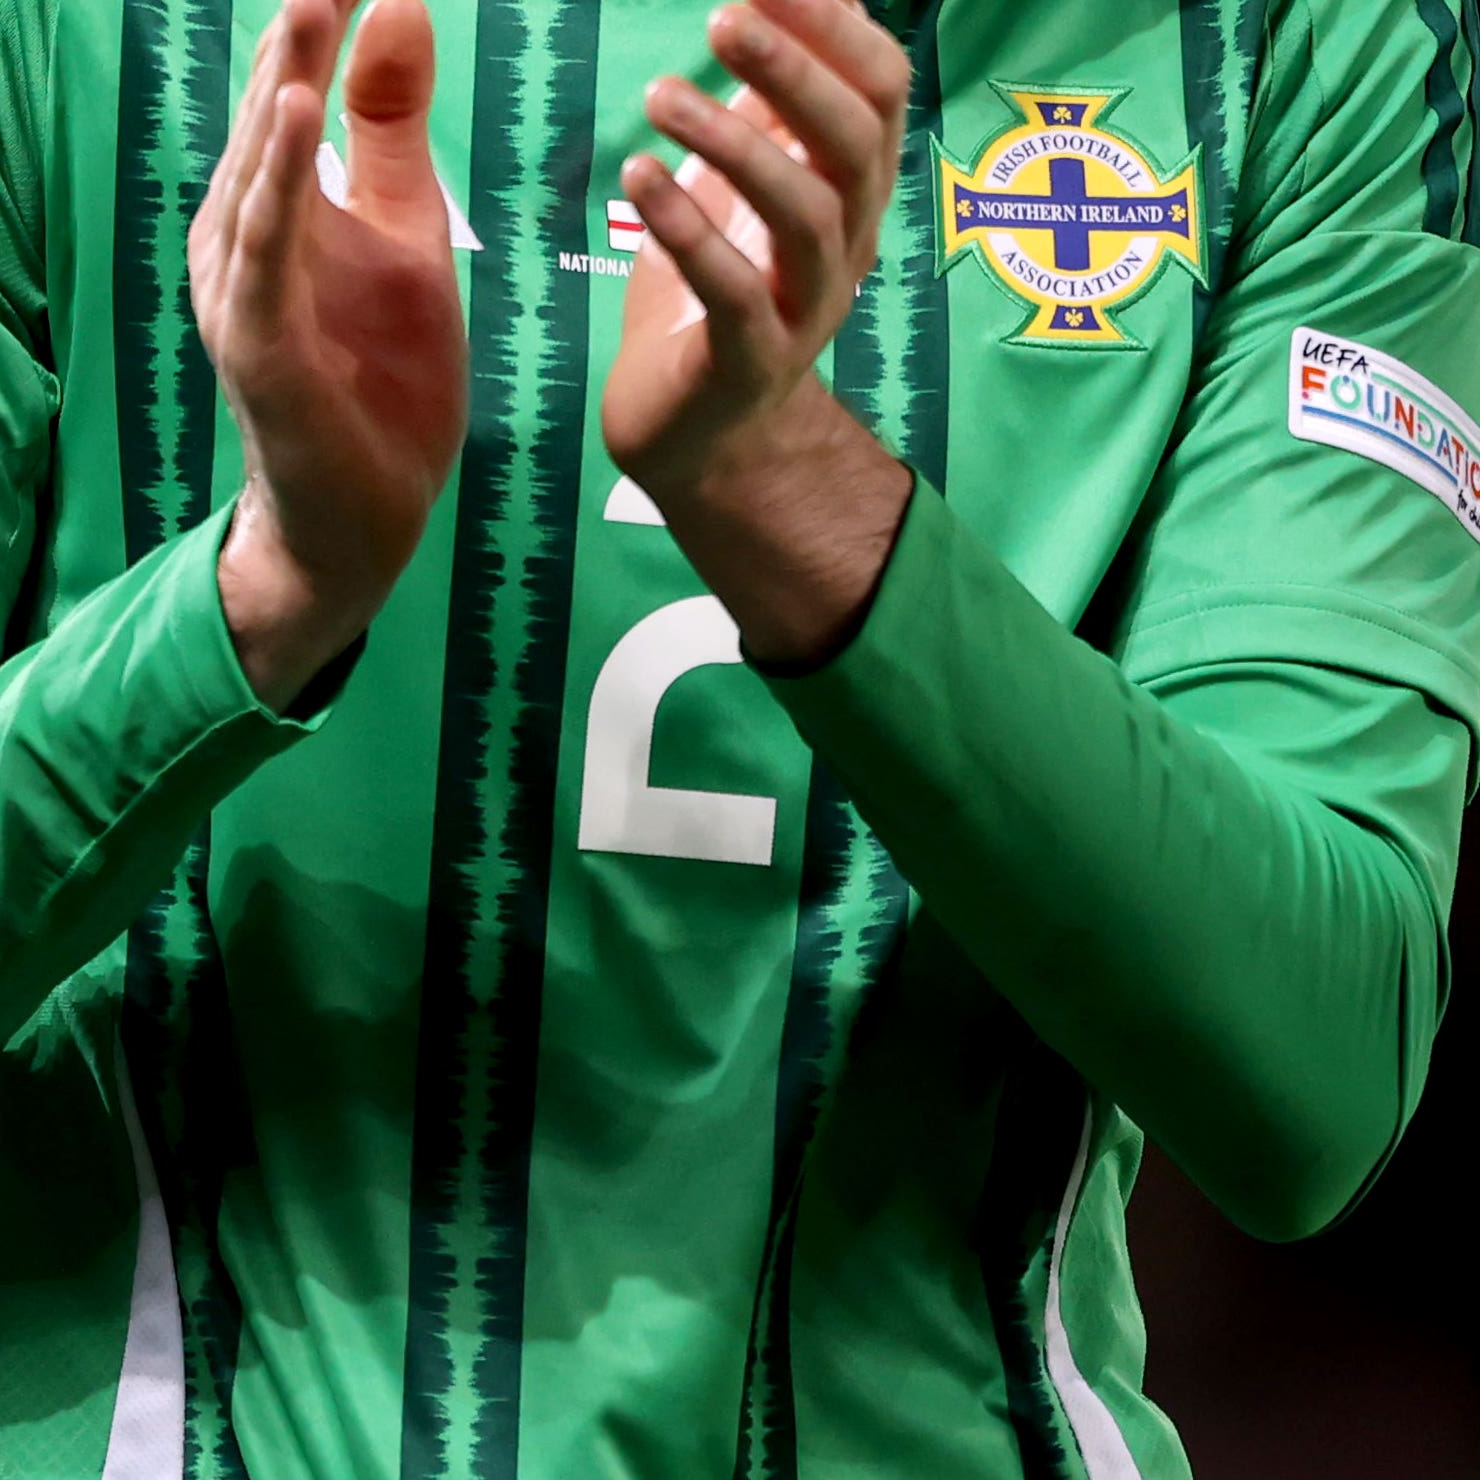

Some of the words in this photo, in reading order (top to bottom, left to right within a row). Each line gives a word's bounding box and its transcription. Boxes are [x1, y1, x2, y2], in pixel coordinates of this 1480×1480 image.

[992, 139, 1038, 185] IRISH
[1038, 134, 1141, 188] FOOTBALL
[977, 201, 1077, 223] NORTHERN
[1080, 205, 1163, 224] IRELAND
[1001, 250, 1144, 298] ASSOCIATION
[1302, 337, 1369, 374] UEFA
